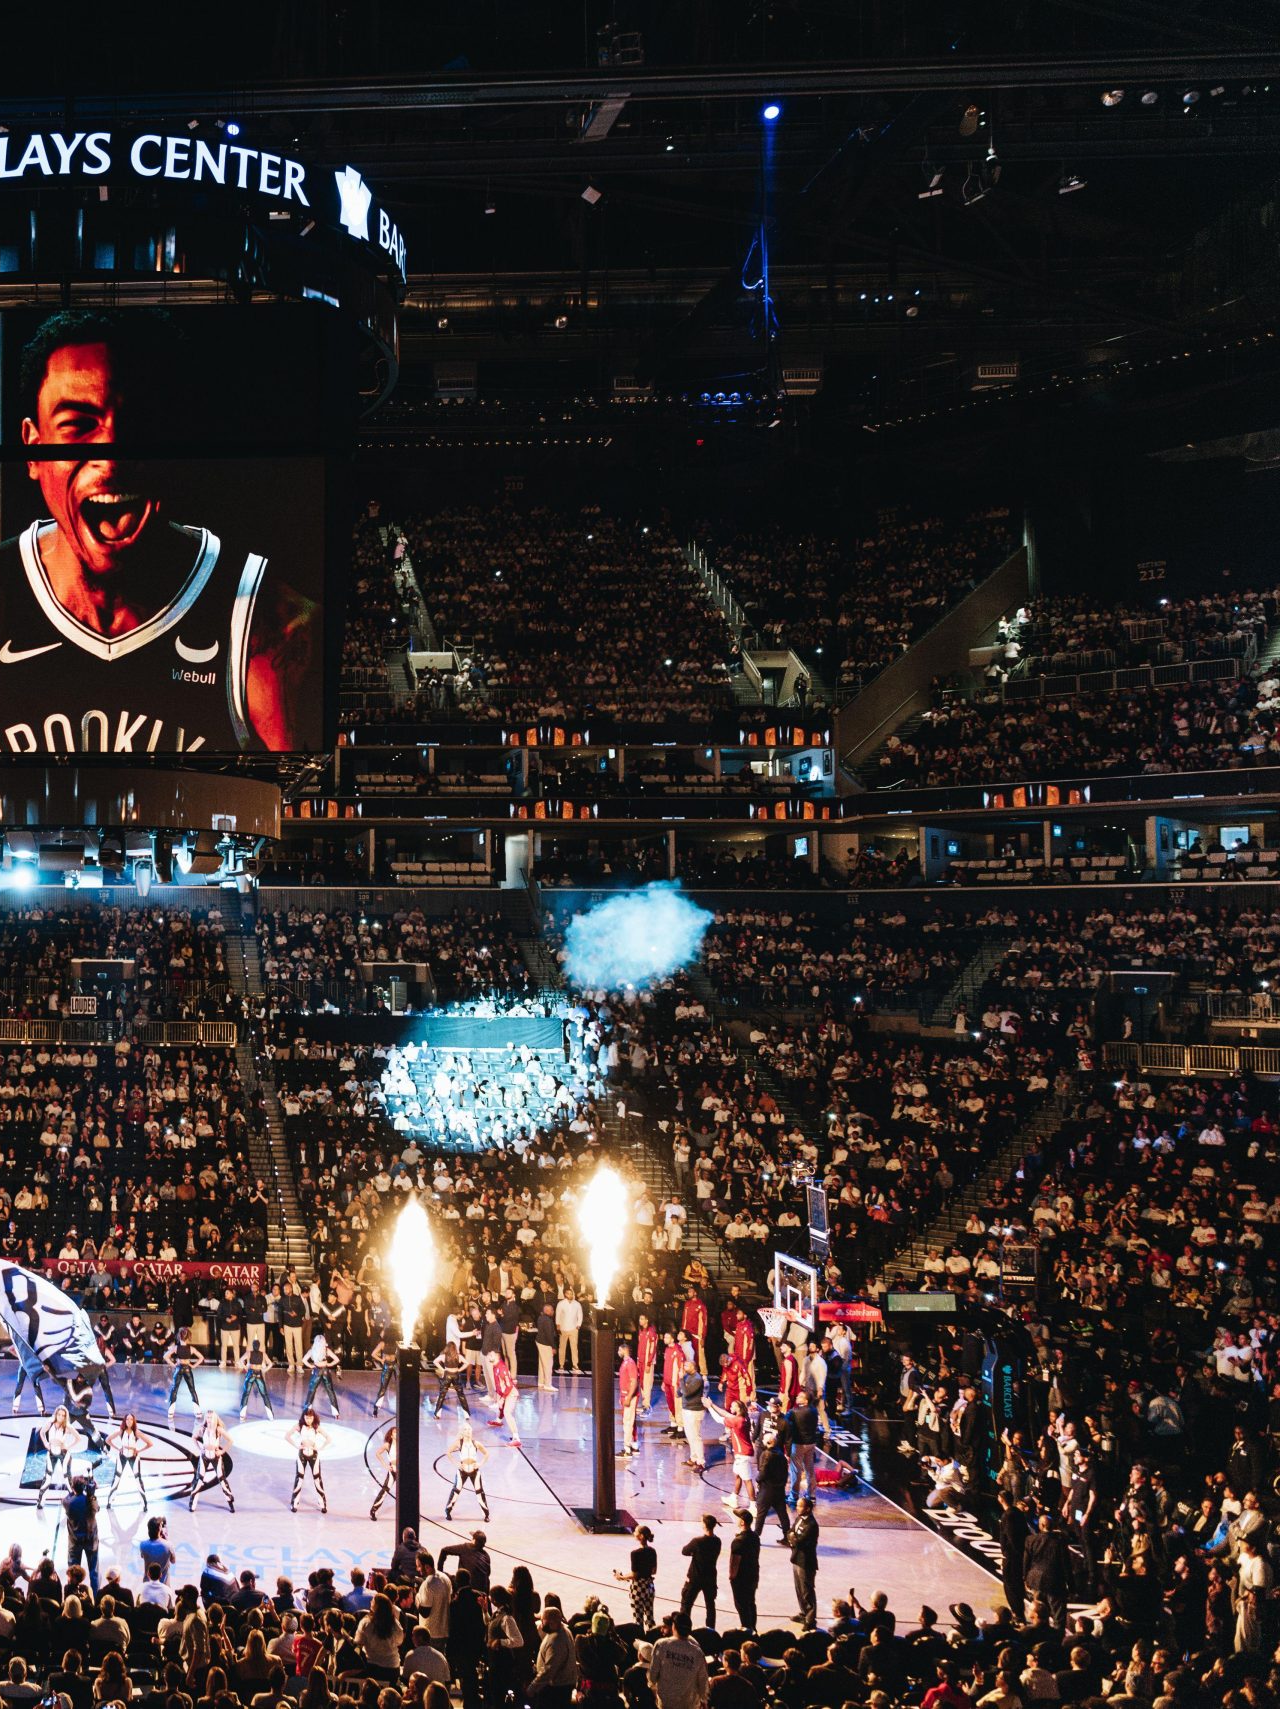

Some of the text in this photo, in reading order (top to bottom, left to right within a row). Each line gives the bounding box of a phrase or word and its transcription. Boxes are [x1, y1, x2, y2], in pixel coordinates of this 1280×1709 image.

[130, 134, 310, 206] CENTER
[1139, 568, 1166, 582] 212
[172, 668, 216, 685] Webull
[71, 997, 96, 1013] LOUDER
[210, 1264, 260, 1278] QATAR
[1003, 1375, 1014, 1419] BARCLAYS
[175, 1542, 396, 1566] ARCLAYS
